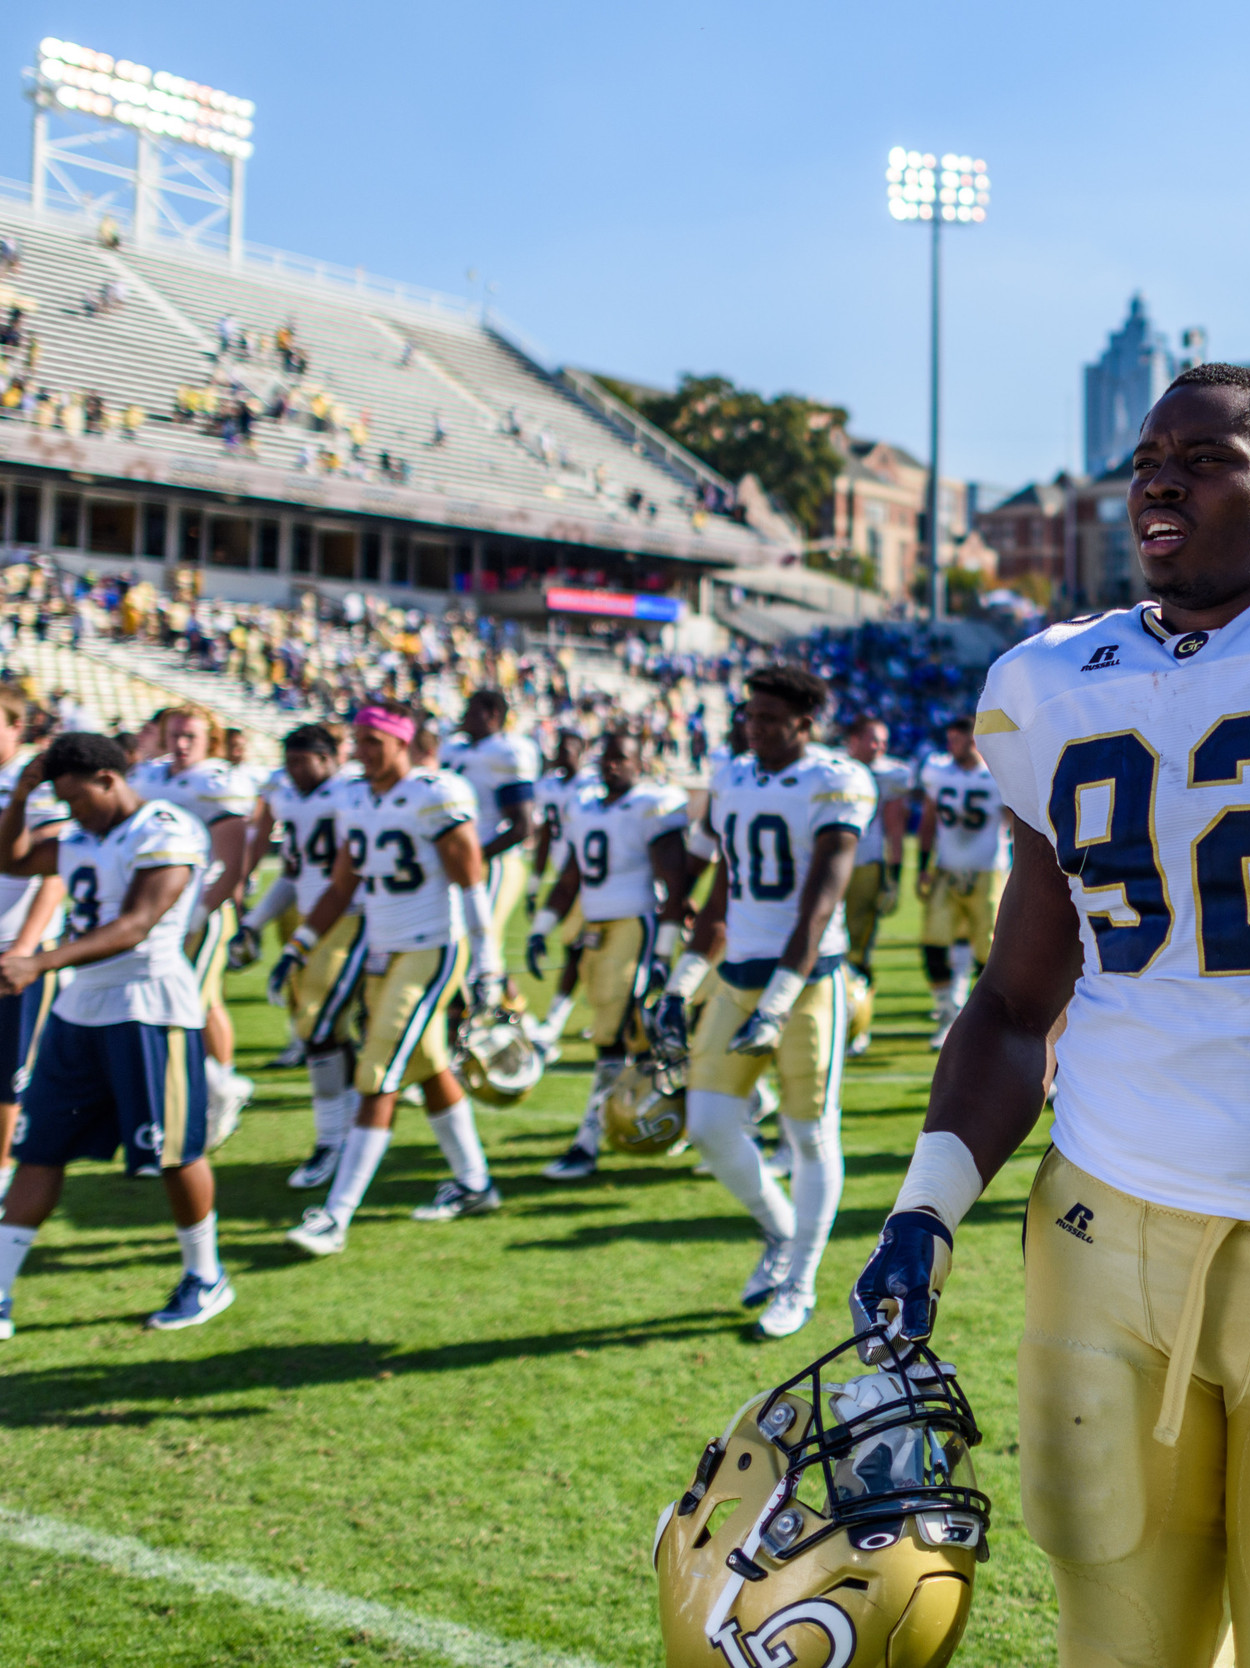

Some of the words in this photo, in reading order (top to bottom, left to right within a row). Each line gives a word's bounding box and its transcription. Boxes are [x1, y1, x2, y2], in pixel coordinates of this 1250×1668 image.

[1080, 658, 1120, 672] RUSSELL
[936, 786, 993, 831] 65
[718, 812, 796, 902] 10
[1055, 1218, 1094, 1244] RUSSELL
